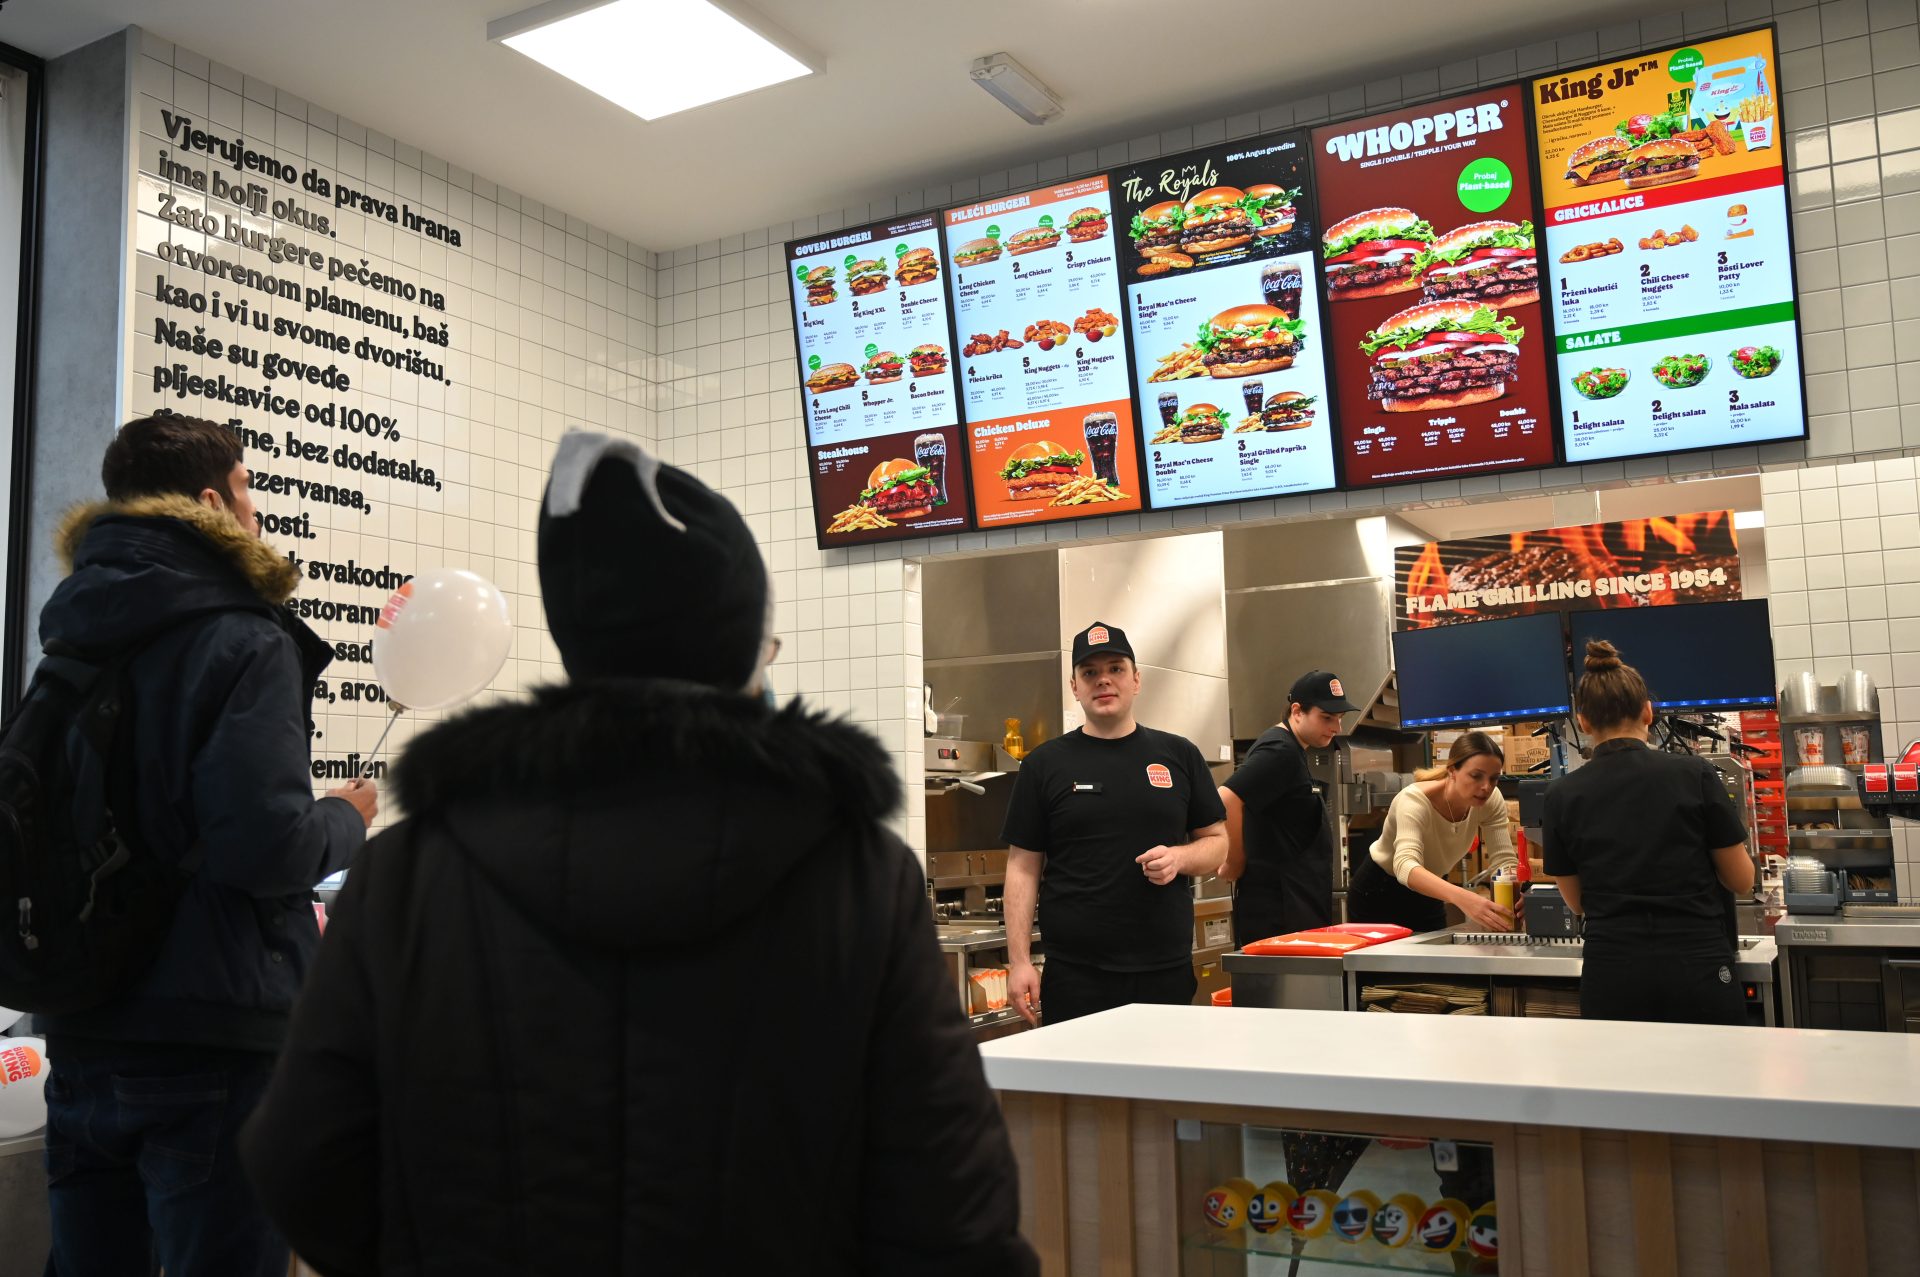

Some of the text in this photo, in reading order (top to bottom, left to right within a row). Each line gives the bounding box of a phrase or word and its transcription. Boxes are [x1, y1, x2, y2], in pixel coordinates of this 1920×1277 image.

[1539, 72, 1604, 105] King
[1226, 142, 1296, 162] 100% Angus govedina
[1360, 139, 1477, 168] SINGLE DOUBLE TRIPPLE YOUR WAY
[161, 109, 462, 248] Vjerujemo da prava hrana
[1121, 176, 1154, 203] The
[1159, 159, 1220, 203] Royals
[1474, 172, 1497, 181] Probaj
[1459, 180, 1510, 191] Plant-based
[158, 150, 337, 239] ima bolji okus.
[951, 196, 1031, 222] PILEĆI BURGERI
[1554, 195, 1645, 222] GRICKALICE
[831, 231, 872, 248] BURGERI
[158, 193, 446, 311] Zato burgere pečemo na
[1066, 251, 1073, 262] 3
[1717, 251, 1728, 265] 3
[1013, 262, 1020, 273] 2
[1067, 256, 1111, 269] Crispy Chicken
[1717, 260, 1764, 273] Rösti Lover
[1640, 264, 1650, 277] 2
[957, 273, 963, 284] 1
[1014, 273, 1028, 281] Long
[1640, 272, 1690, 286] Chili Cheese
[1718, 273, 1740, 281] Patty
[959, 279, 995, 292] Long Chicken
[1560, 277, 1567, 290] 1
[1641, 283, 1673, 294] Nuggets
[157, 240, 449, 348] otvorenom plamenu, baš
[899, 291, 907, 301] 3
[959, 289, 979, 298] Cheese
[1561, 282, 1618, 299] Prženi kolutići
[901, 296, 938, 309] Double Cheese
[1136, 293, 1142, 305] 1
[1138, 303, 1156, 312] Royal
[1174, 297, 1197, 305] Cheese
[1562, 298, 1579, 306] luka
[852, 301, 859, 311] 2
[802, 311, 808, 321] 1
[862, 309, 875, 318] King
[1138, 310, 1158, 319] Single
[812, 318, 824, 327] King
[156, 275, 452, 386] kao i vi u svome dvorištu.
[1565, 330, 1621, 350] SALATE
[154, 317, 350, 392] Naše su goveđe
[1076, 347, 1083, 358] 6
[1023, 357, 1030, 368] 5
[1077, 355, 1114, 367] King Nuggets
[968, 366, 976, 377] 4
[1024, 364, 1061, 375] King Nuggets
[985, 373, 1003, 381] krilca
[909, 382, 916, 393] 6
[861, 390, 868, 401] 5
[911, 389, 945, 399] Bacon Deluxe
[1729, 390, 1739, 403] 3
[153, 363, 401, 443] pljeskavice od 100%
[813, 398, 820, 409] 4
[863, 399, 885, 408] Whopper
[1651, 400, 1662, 413] 2
[1729, 400, 1775, 411] Mala salata
[814, 414, 831, 422] Cheese
[1499, 407, 1526, 417] Double
[1572, 410, 1579, 422] 1
[1652, 408, 1706, 421] Delight salata
[1428, 417, 1456, 426] Tripple
[1573, 417, 1625, 431] Delight salata
[974, 418, 1051, 438] Chicken Deluxe
[1363, 426, 1386, 435] Single
[1238, 439, 1246, 451] 3
[817, 445, 869, 460] Steakhouse
[1153, 451, 1161, 462] 2
[1239, 444, 1307, 459] Royal Grilled Paprika
[286, 432, 329, 463] bez
[333, 445, 442, 492] dodataka,
[1155, 461, 1172, 470] Royal
[1191, 456, 1213, 465] Cheese
[1239, 457, 1259, 466] Single
[1155, 468, 1177, 476] Double
[1405, 566, 1728, 614] FLAME GRILLING SINCE 1954
[1089, 634, 1108, 642] KING
[1150, 775, 1171, 783] KING
[0, 1049, 23, 1083] KING
[13, 1046, 32, 1079] BURGER
